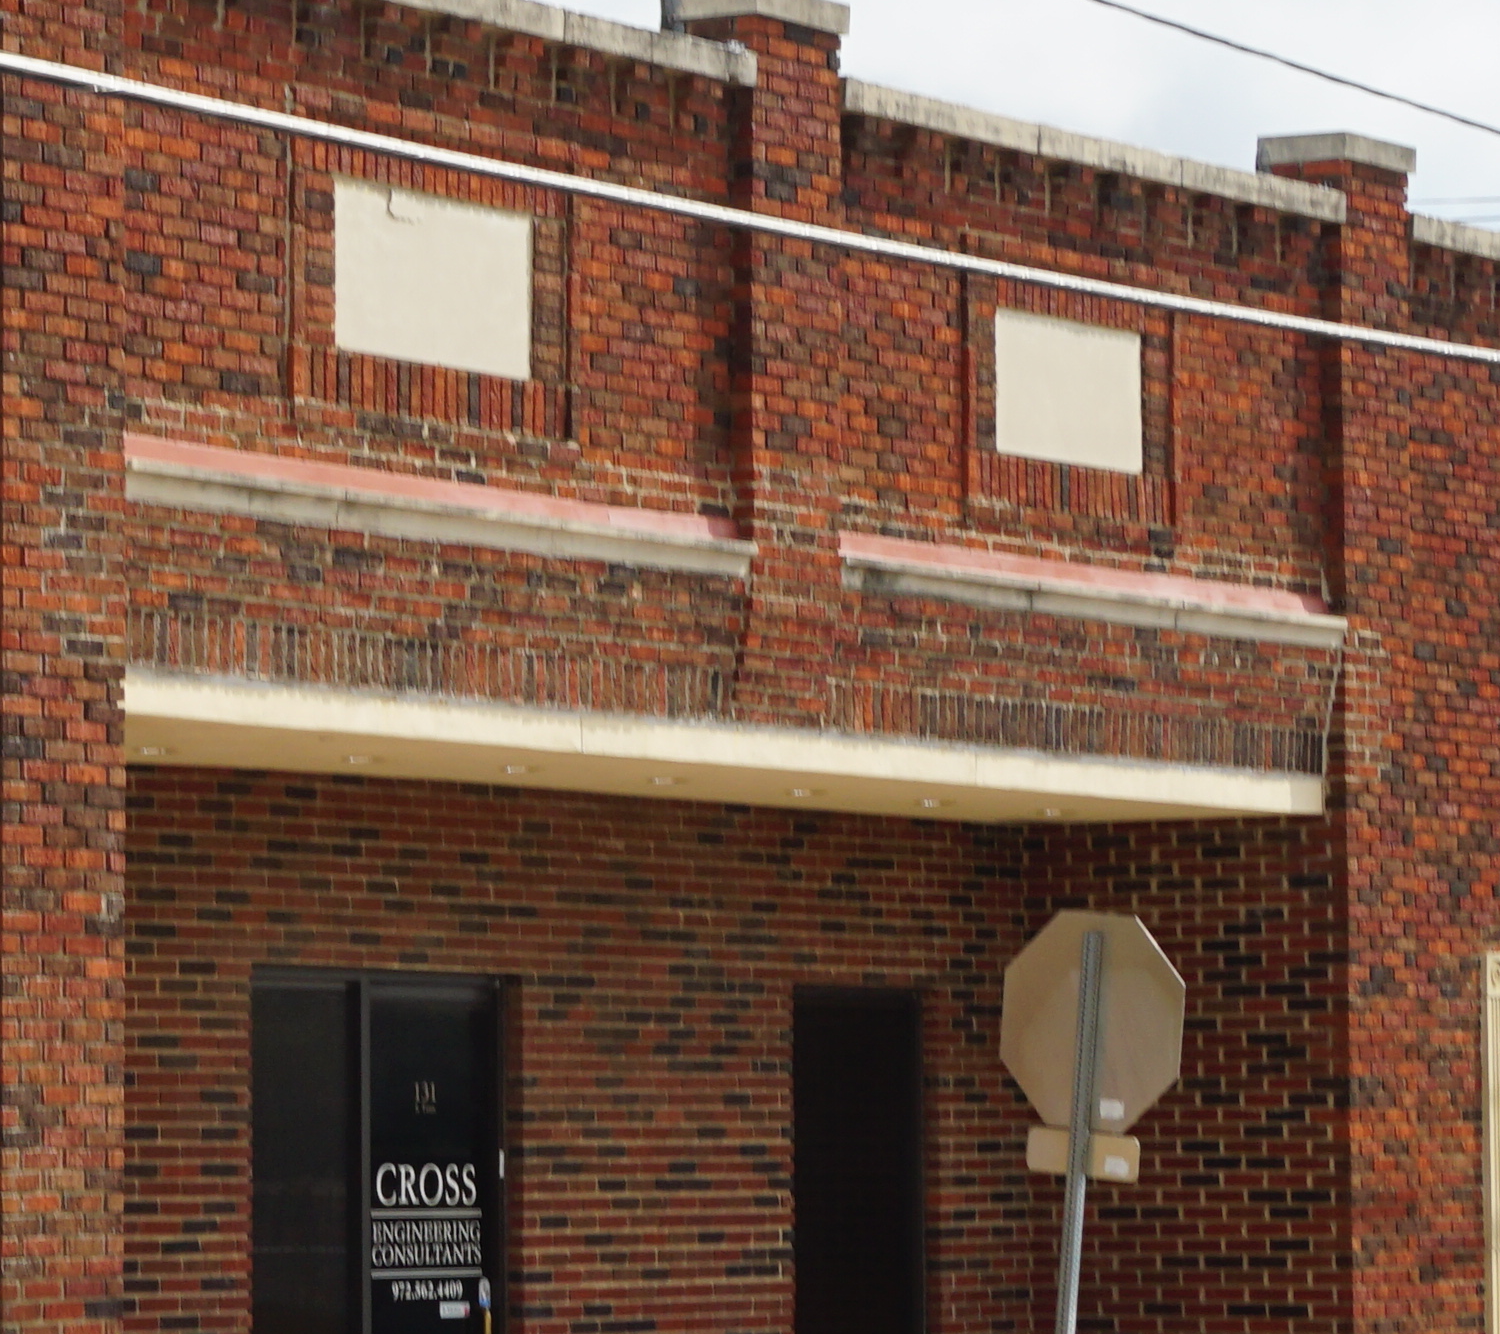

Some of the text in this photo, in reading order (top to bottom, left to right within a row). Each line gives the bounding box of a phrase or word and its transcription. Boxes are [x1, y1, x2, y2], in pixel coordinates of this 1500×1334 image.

[414, 1080, 437, 1103] 131
[376, 1162, 477, 1206] CROSS
[372, 1219, 481, 1244] ENGINEERING
[371, 1242, 482, 1267] CONSULTANTS
